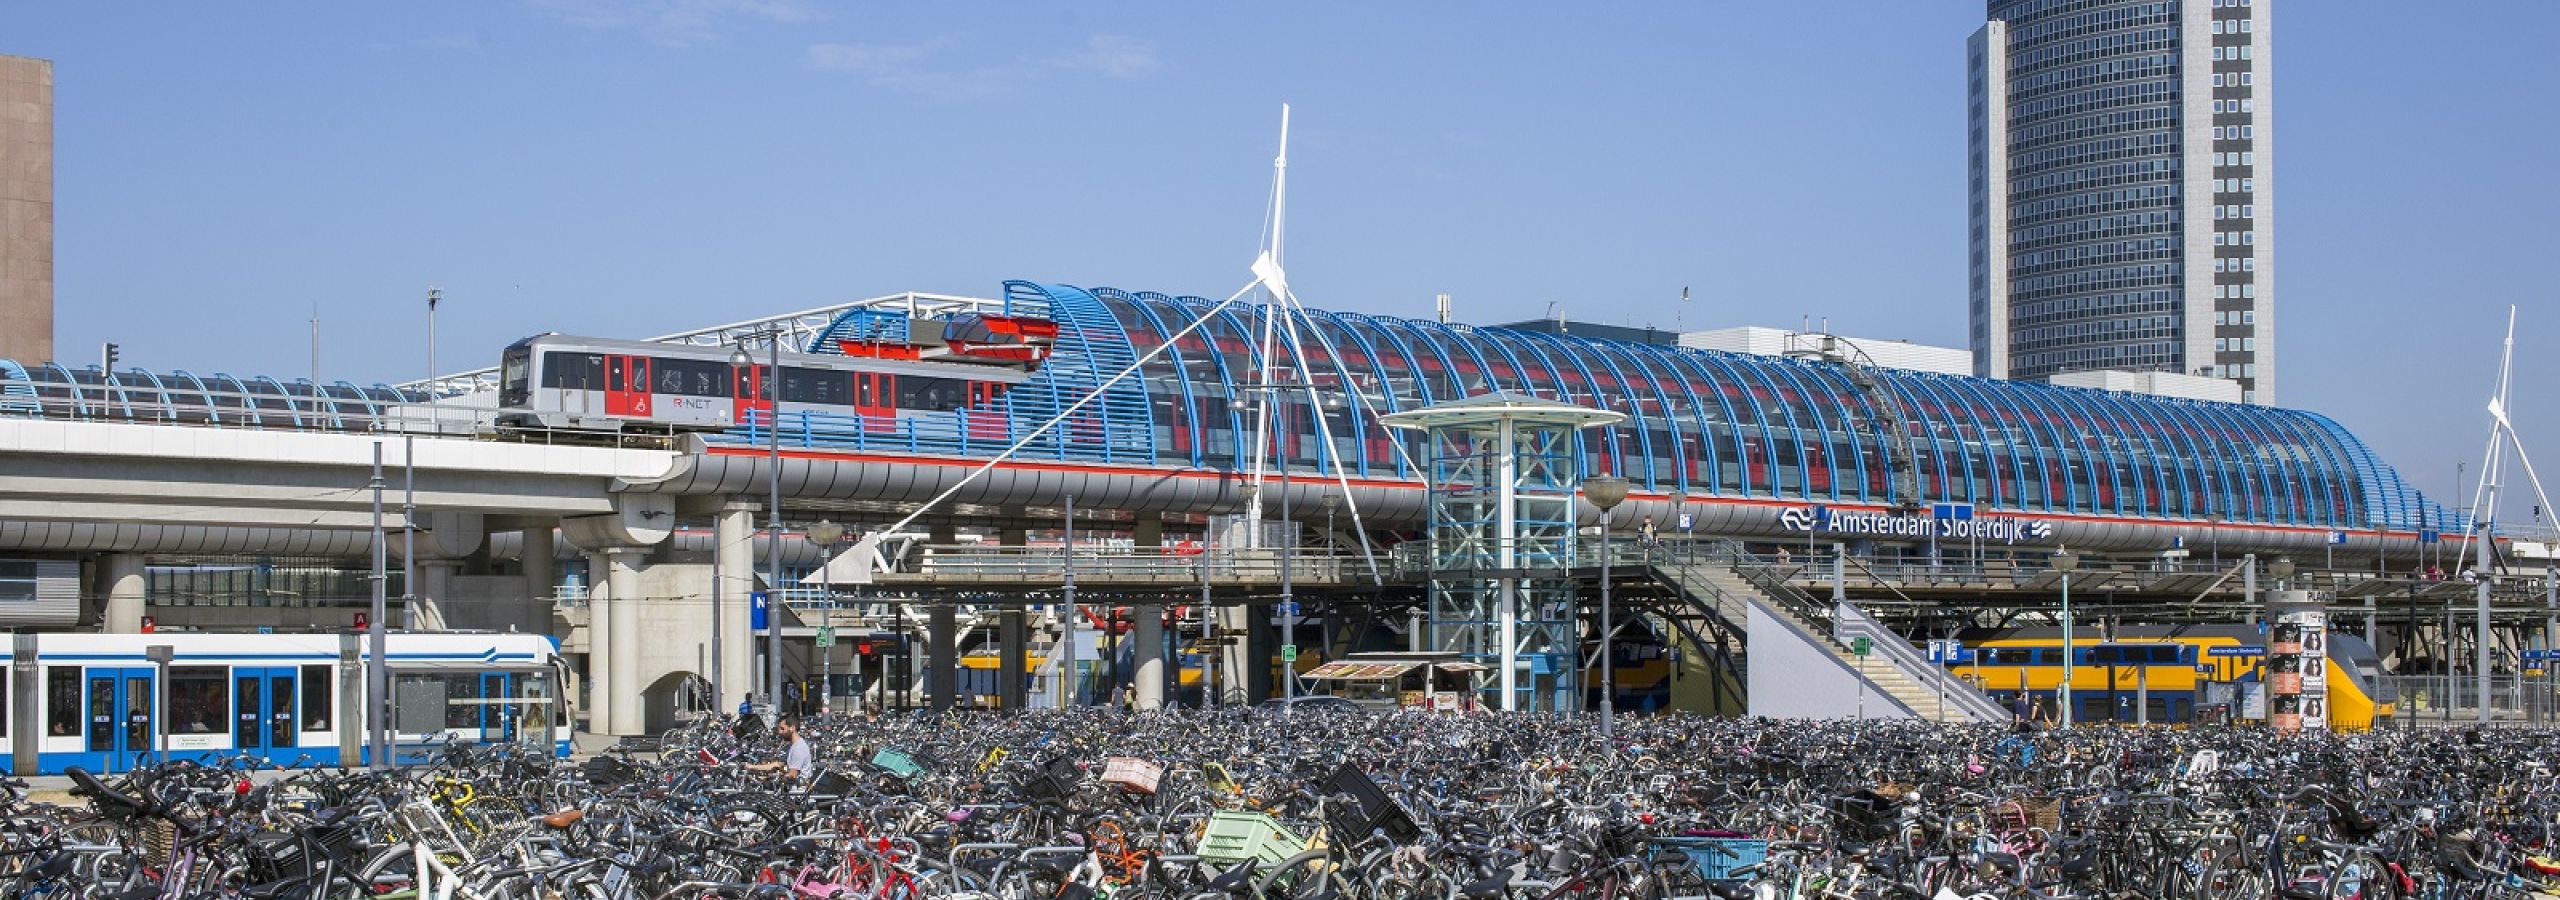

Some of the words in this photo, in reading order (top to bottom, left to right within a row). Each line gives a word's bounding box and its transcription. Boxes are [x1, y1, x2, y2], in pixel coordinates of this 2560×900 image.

[1828, 509, 1932, 536] Amsterdam
[1941, 516, 2024, 545] Sloterdijk
[2121, 695, 2129, 706] 2
